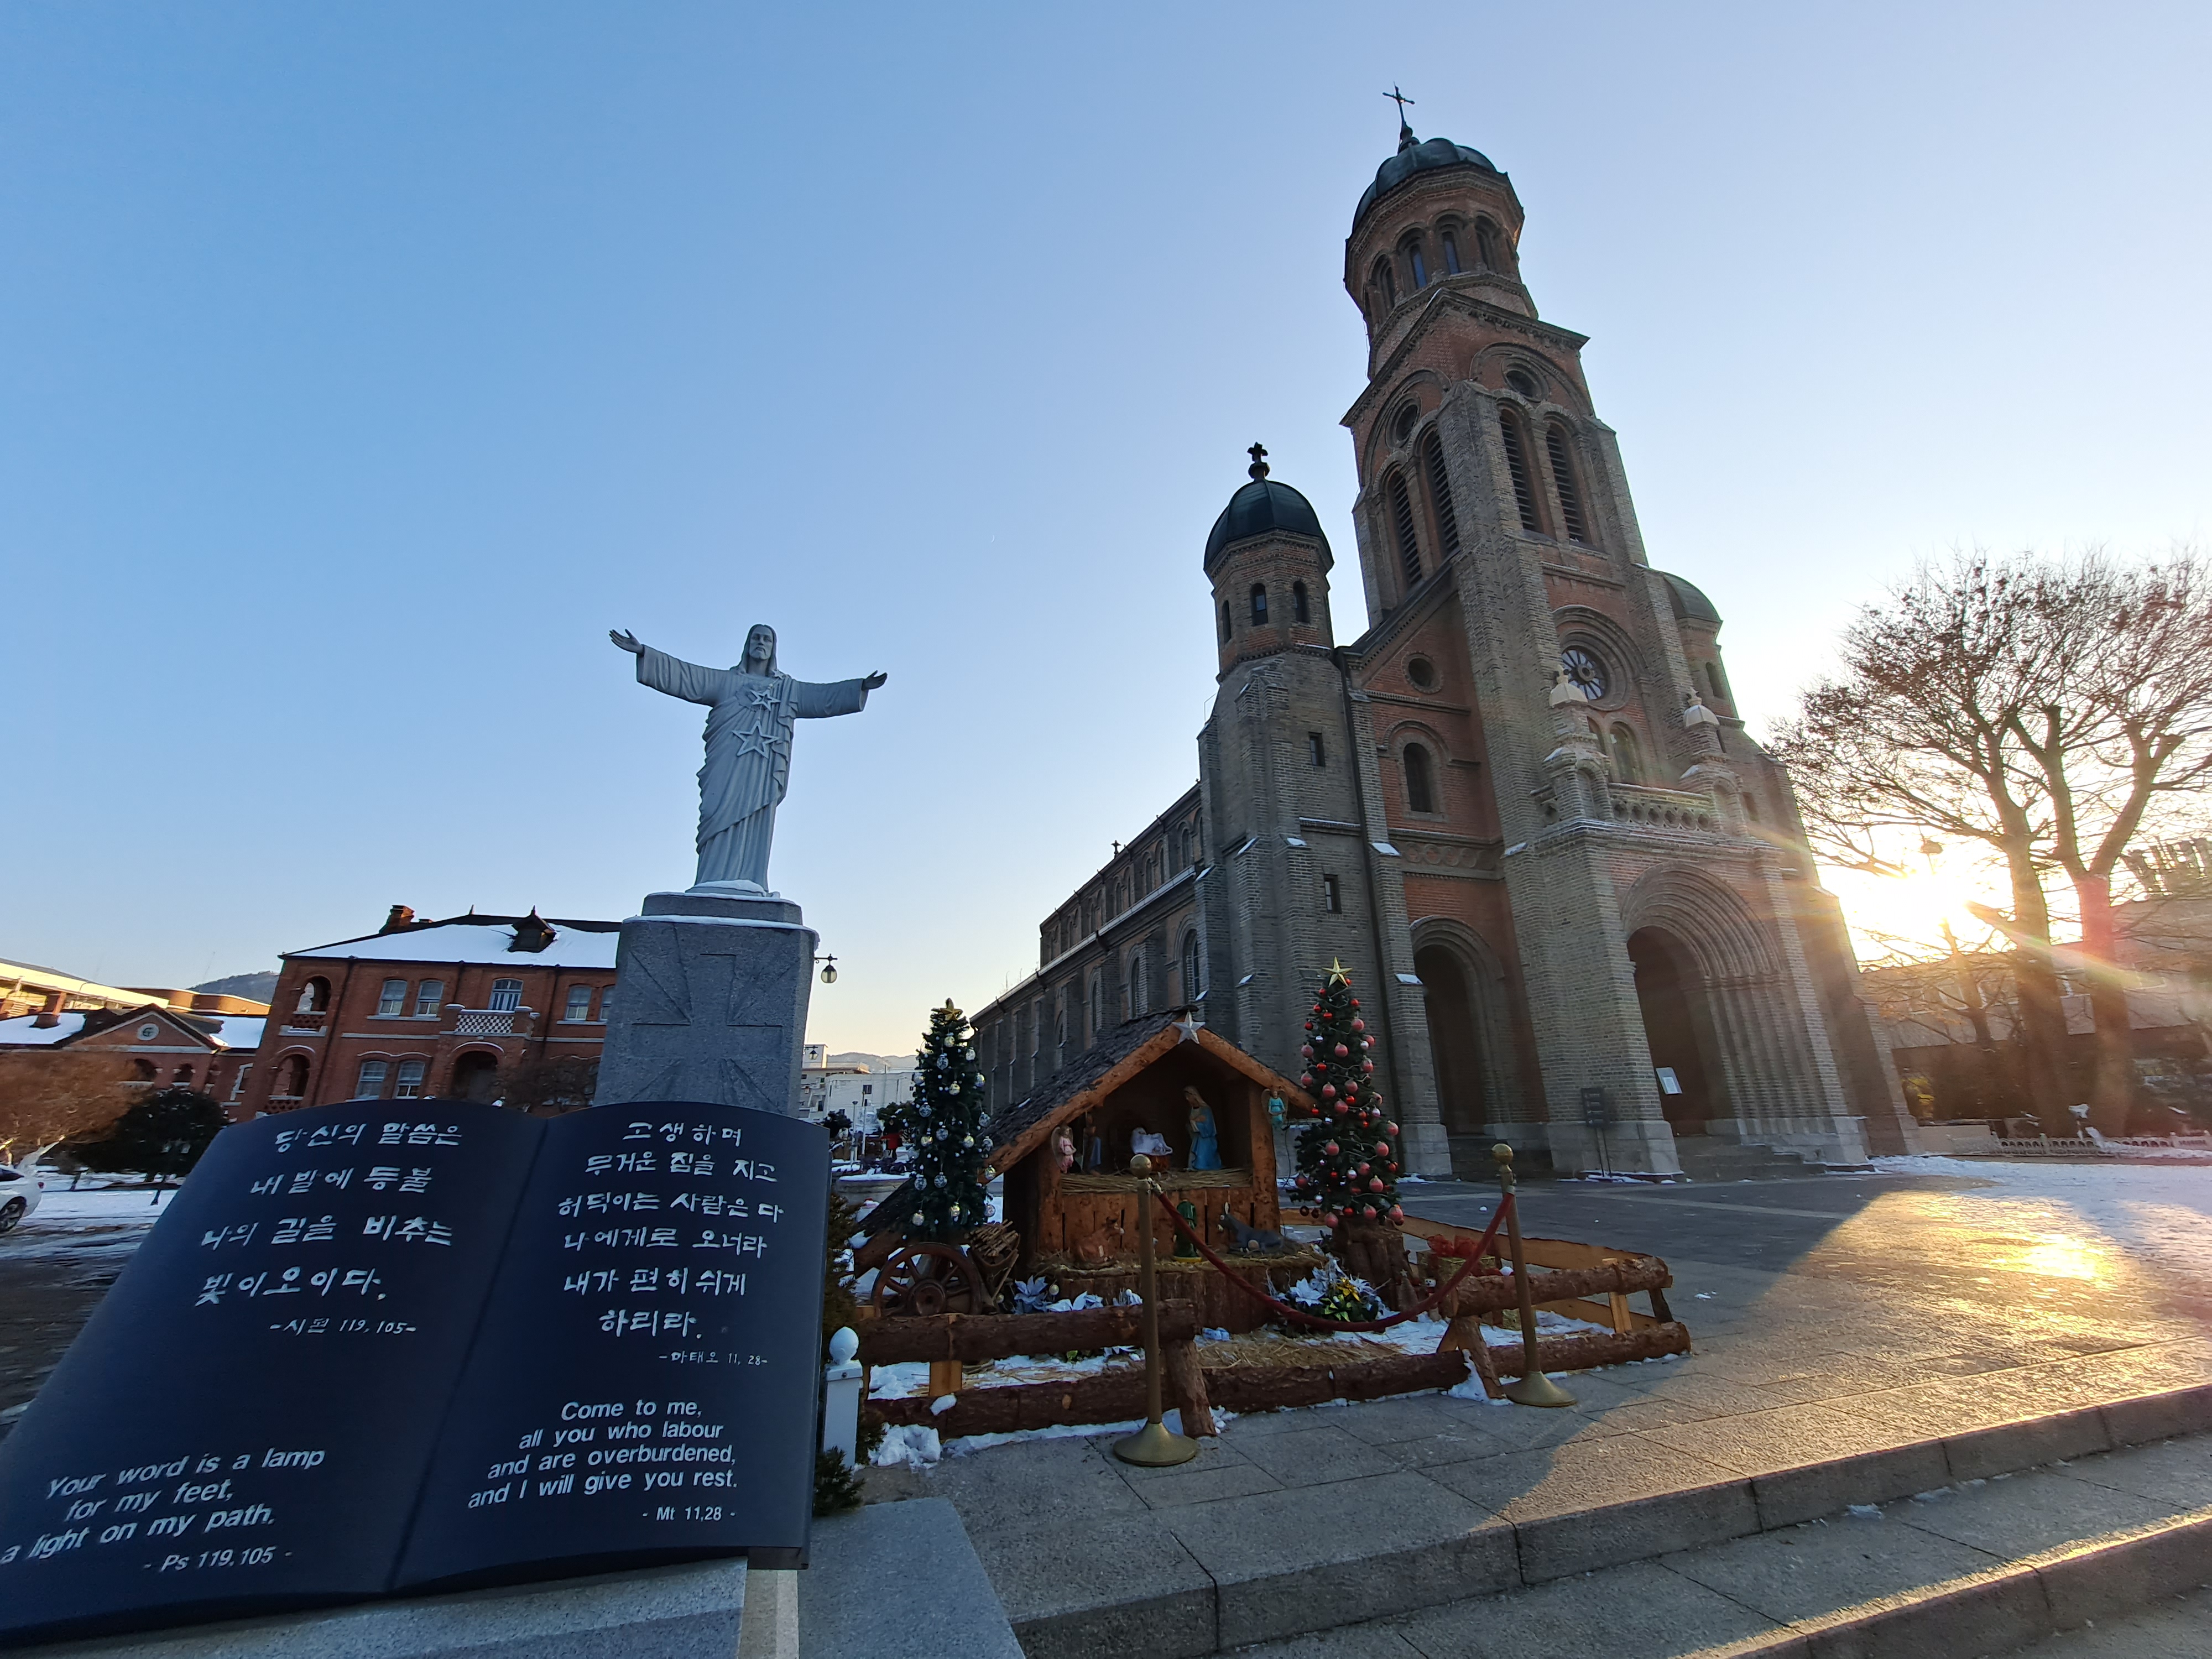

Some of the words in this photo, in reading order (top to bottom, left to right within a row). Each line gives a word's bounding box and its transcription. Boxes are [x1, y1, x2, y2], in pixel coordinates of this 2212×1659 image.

[275, 1123, 367, 1153] 당신의
[378, 1123, 462, 1146] 말씀은
[622, 1122, 742, 1147] 고생하며
[363, 1166, 432, 1193] 등불
[585, 1151, 656, 1176] 무거운
[670, 1152, 715, 1176] 짐을
[733, 1159, 777, 1182] 지고
[558, 1192, 660, 1218] 허덕이는
[670, 1193, 749, 1218] 사람은
[758, 1203, 784, 1223] 다
[201, 1222, 259, 1250] 나의
[270, 1215, 337, 1244] 길을
[363, 1215, 452, 1246] 비추는
[564, 1226, 679, 1251] 나에게로
[692, 1230, 768, 1259] 오너라
[564, 1269, 619, 1296] 내가
[599, 1309, 702, 1339] 하리라.
[561, 1401, 624, 1421] Come
[635, 1399, 657, 1416] to
[666, 1401, 701, 1417] me,
[519, 1428, 544, 1449] all
[553, 1427, 596, 1448] you
[608, 1421, 652, 1439] who
[662, 1421, 724, 1438] labour
[46, 1473, 107, 1499] Your
[116, 1455, 191, 1484] word
[195, 1453, 221, 1473] is
[232, 1454, 251, 1470] a
[261, 1448, 325, 1470] lamp
[487, 1454, 530, 1480] and
[538, 1453, 576, 1471] are
[587, 1443, 735, 1465] overburdened,
[64, 1499, 107, 1521] for
[114, 1490, 161, 1513] my
[173, 1478, 233, 1504] feet,
[468, 1482, 511, 1509] and
[519, 1479, 528, 1499] I
[539, 1473, 575, 1496] will
[584, 1470, 632, 1495] give
[644, 1472, 684, 1491] you
[693, 1469, 737, 1488] rest.
[656, 1506, 675, 1521] Mt
[0, 1545, 21, 1564] a
[27, 1527, 90, 1559] light
[99, 1522, 138, 1543] on
[147, 1514, 196, 1537] my
[204, 1503, 274, 1533] path.
[160, 1554, 190, 1572] Ps
